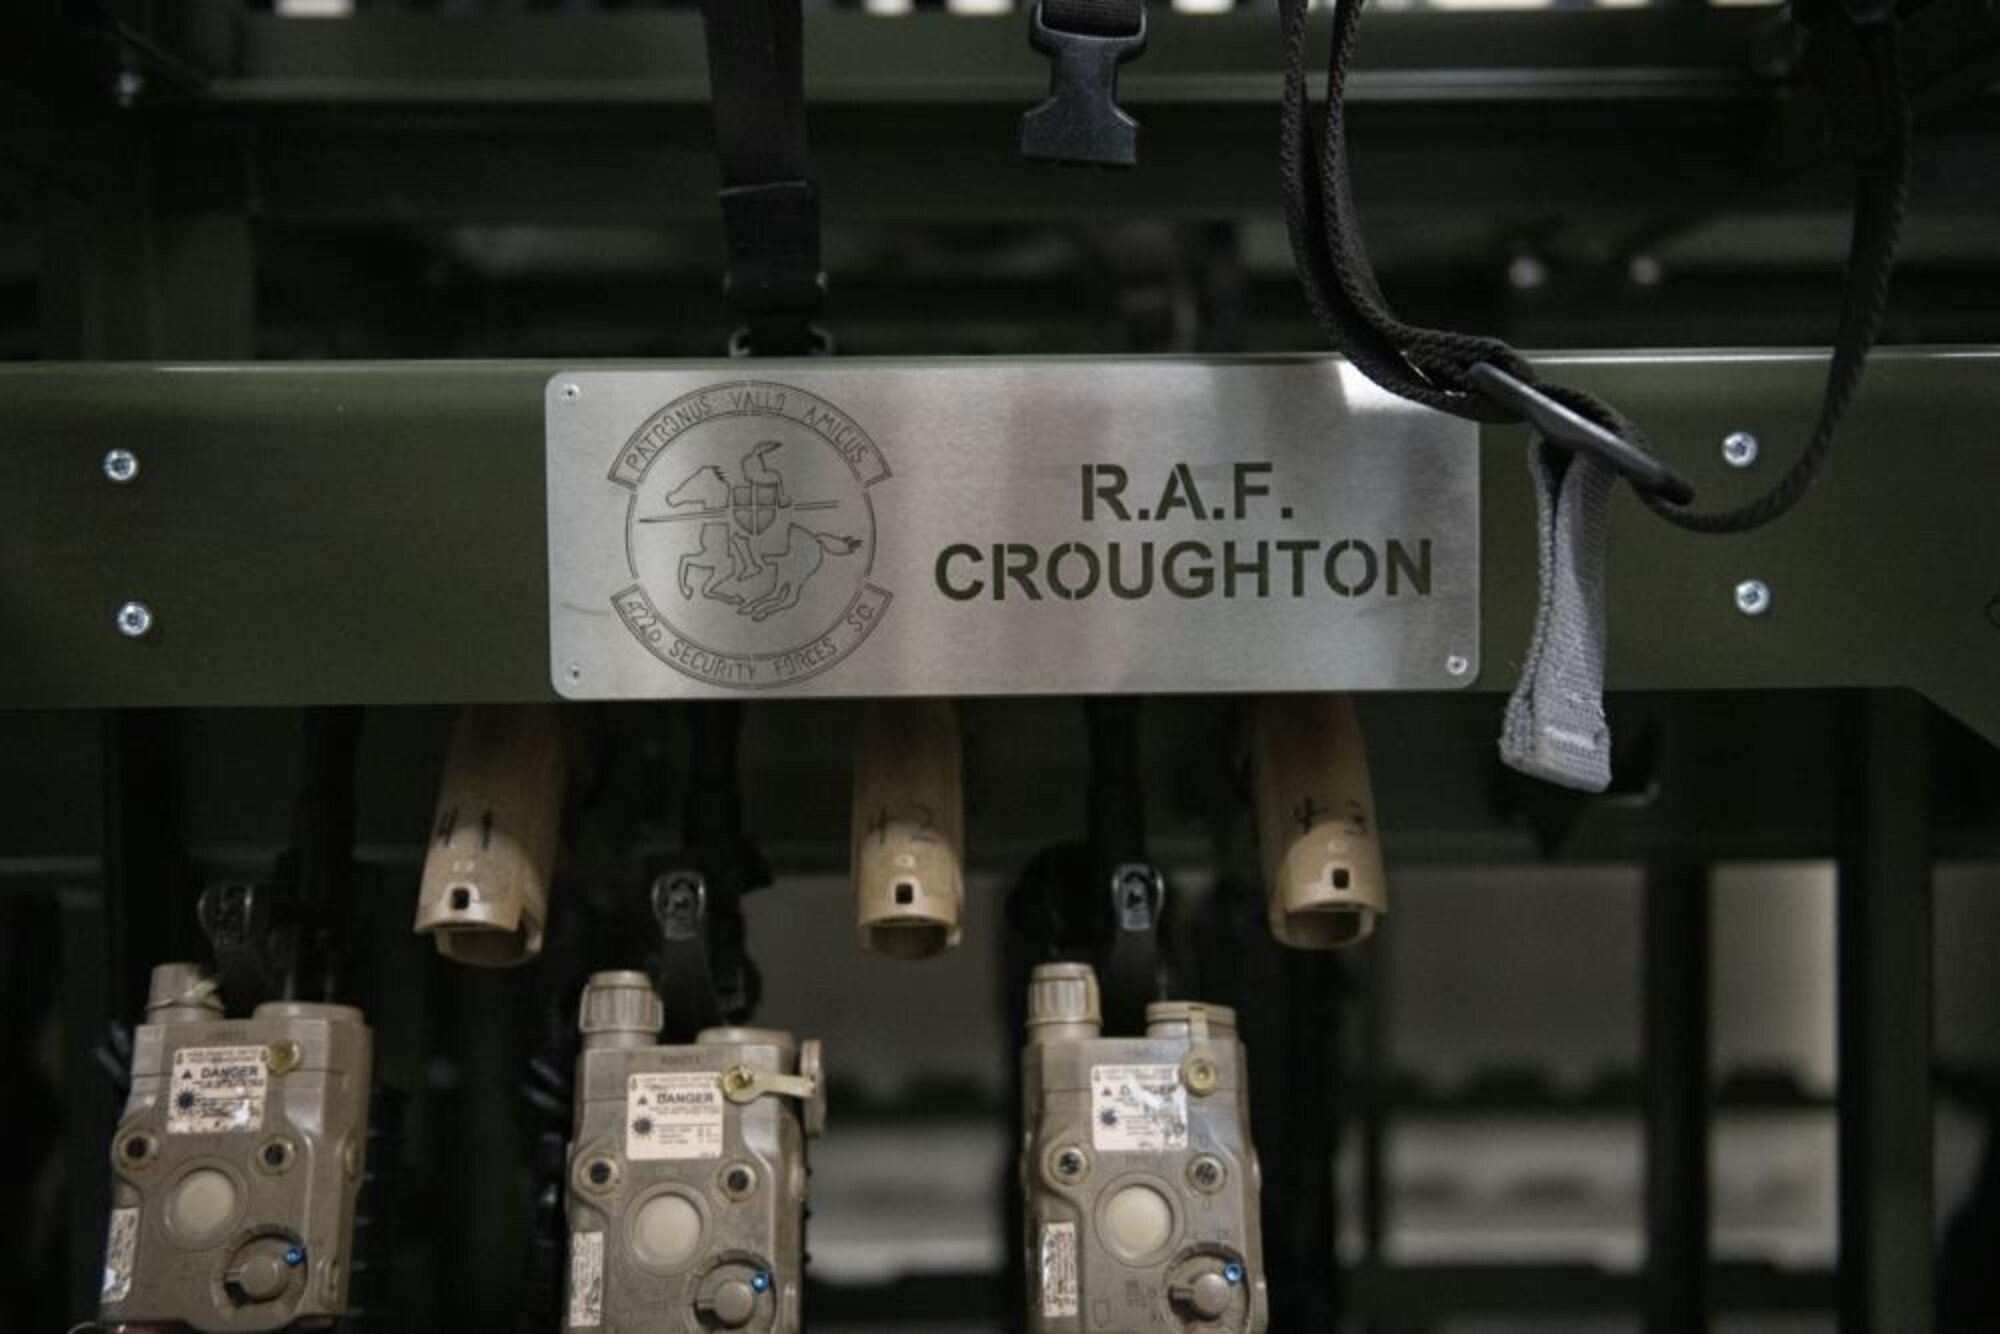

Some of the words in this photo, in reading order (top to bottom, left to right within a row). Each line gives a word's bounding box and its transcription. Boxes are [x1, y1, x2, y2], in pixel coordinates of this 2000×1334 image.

[626, 396, 713, 473] PATRONUS
[804, 405, 871, 463] AMICUS
[1082, 462, 1293, 521] R.A.F.
[935, 538, 1432, 601] CROUGHTON
[669, 640, 756, 680] SECURITY
[774, 638, 838, 675] FORCES
[848, 604, 875, 632] SQ
[201, 1066, 259, 1078] DANGER
[656, 1093, 714, 1104] DANGER
